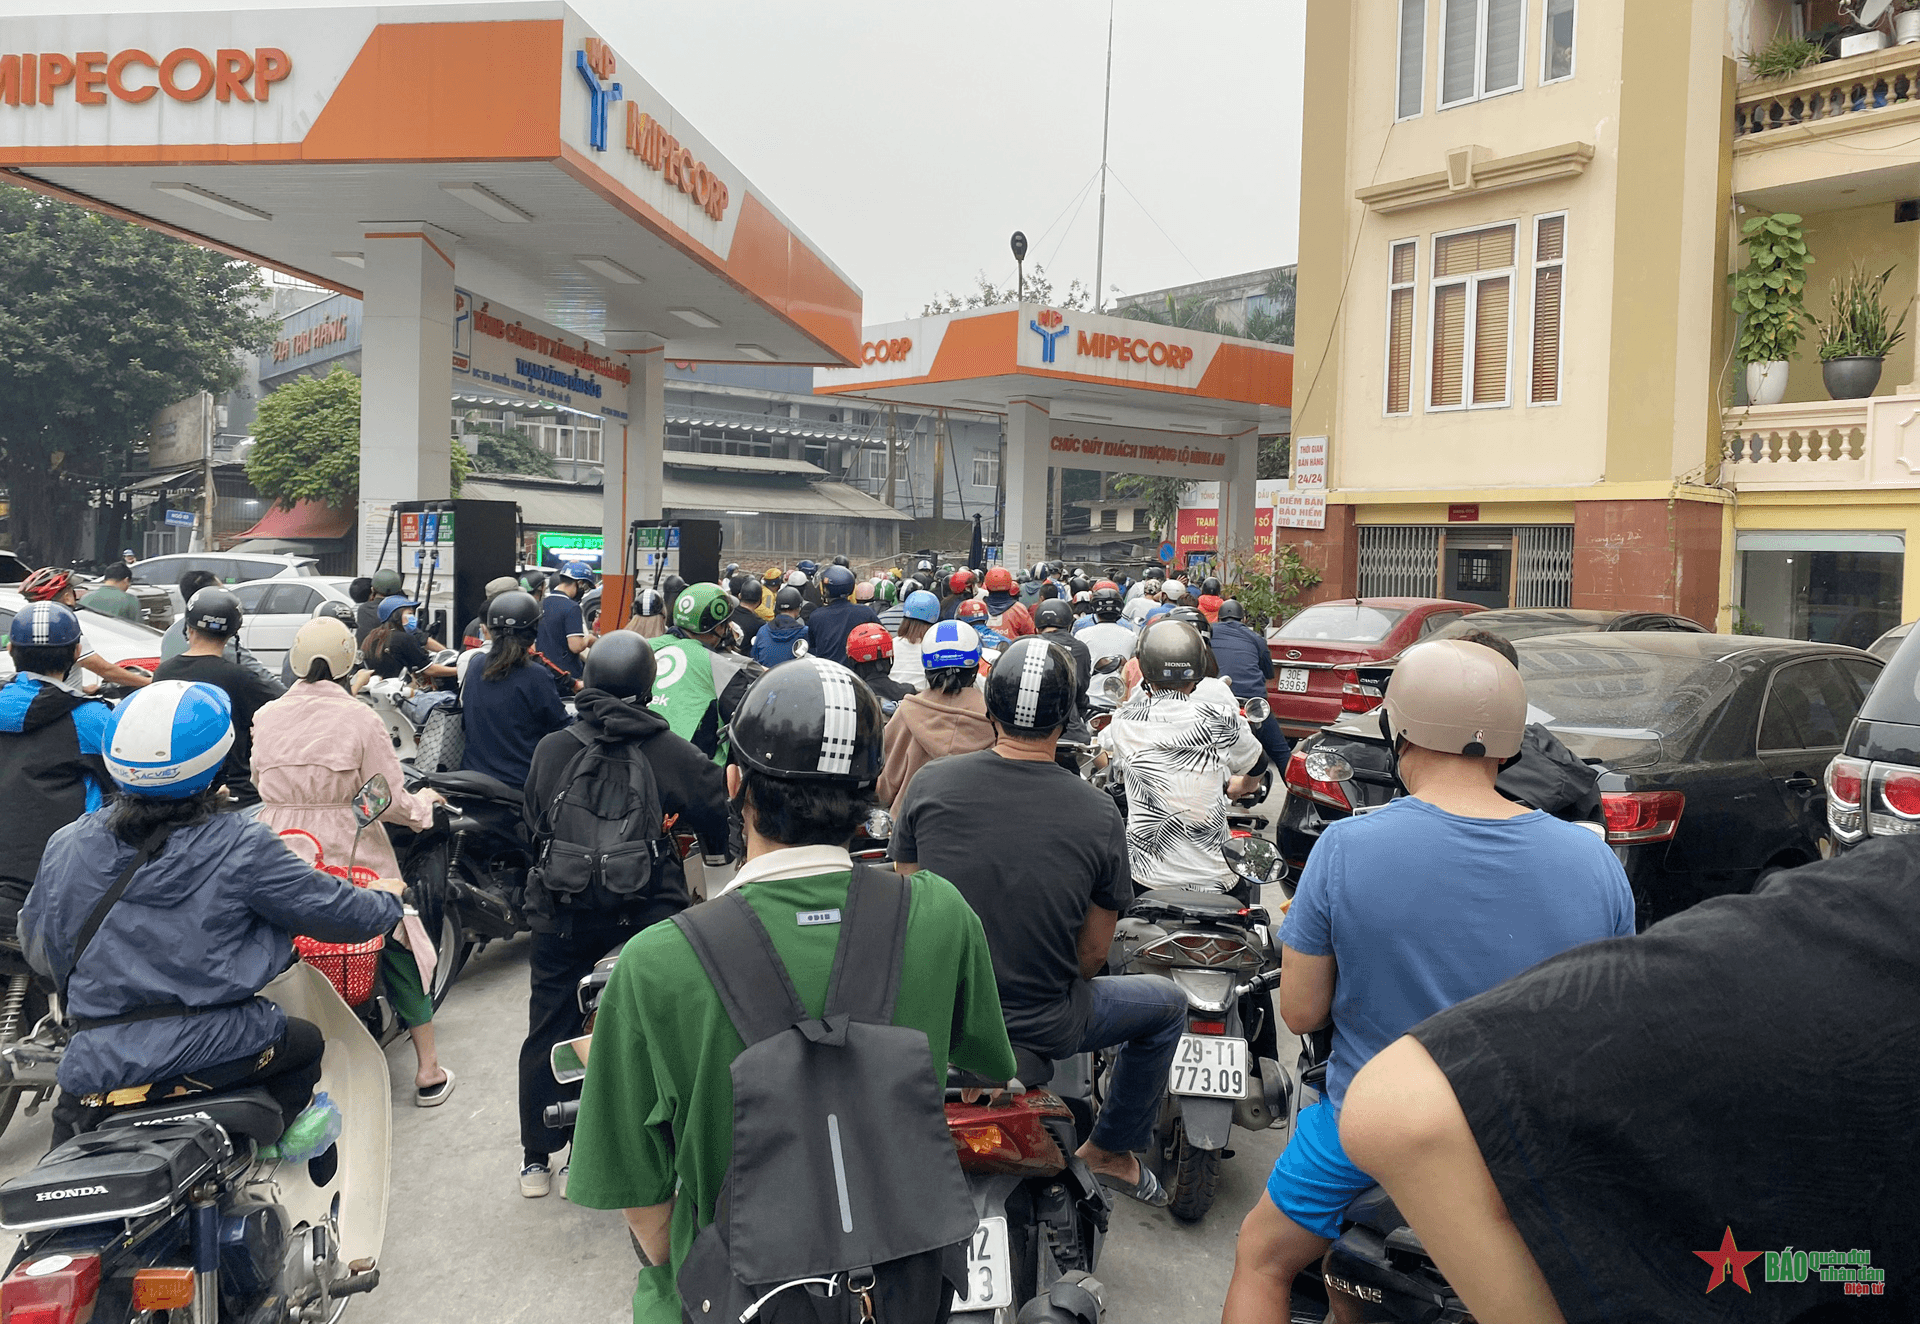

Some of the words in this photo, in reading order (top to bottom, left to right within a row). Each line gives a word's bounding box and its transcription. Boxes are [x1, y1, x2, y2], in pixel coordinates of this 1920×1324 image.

[626, 100, 729, 221] MIPECORP
[860, 336, 913, 365] CORP
[1077, 330, 1193, 370] MIPECORP
[1051, 433, 1081, 452] CHÚC
[1081, 437, 1103, 455] QUÝ
[1103, 440, 1138, 459] KHÁCH
[1300, 444, 1311, 454] THỜI
[1311, 444, 1323, 453] GIAN
[1297, 474, 1323, 484] 24/24
[1279, 495, 1302, 505] ĐIỂM
[1196, 517, 1216, 530] TRẠM
[1258, 512, 1270, 527] SỐ
[1296, 518, 1305, 526] XE
[1181, 531, 1200, 544] QUYẾT
[1286, 669, 1302, 681] 30E
[1279, 679, 1307, 692] 539.63
[1181, 1038, 1235, 1066] 29-T1
[1174, 1065, 1242, 1094] 773.09
[36, 1185, 109, 1202] HONDA
